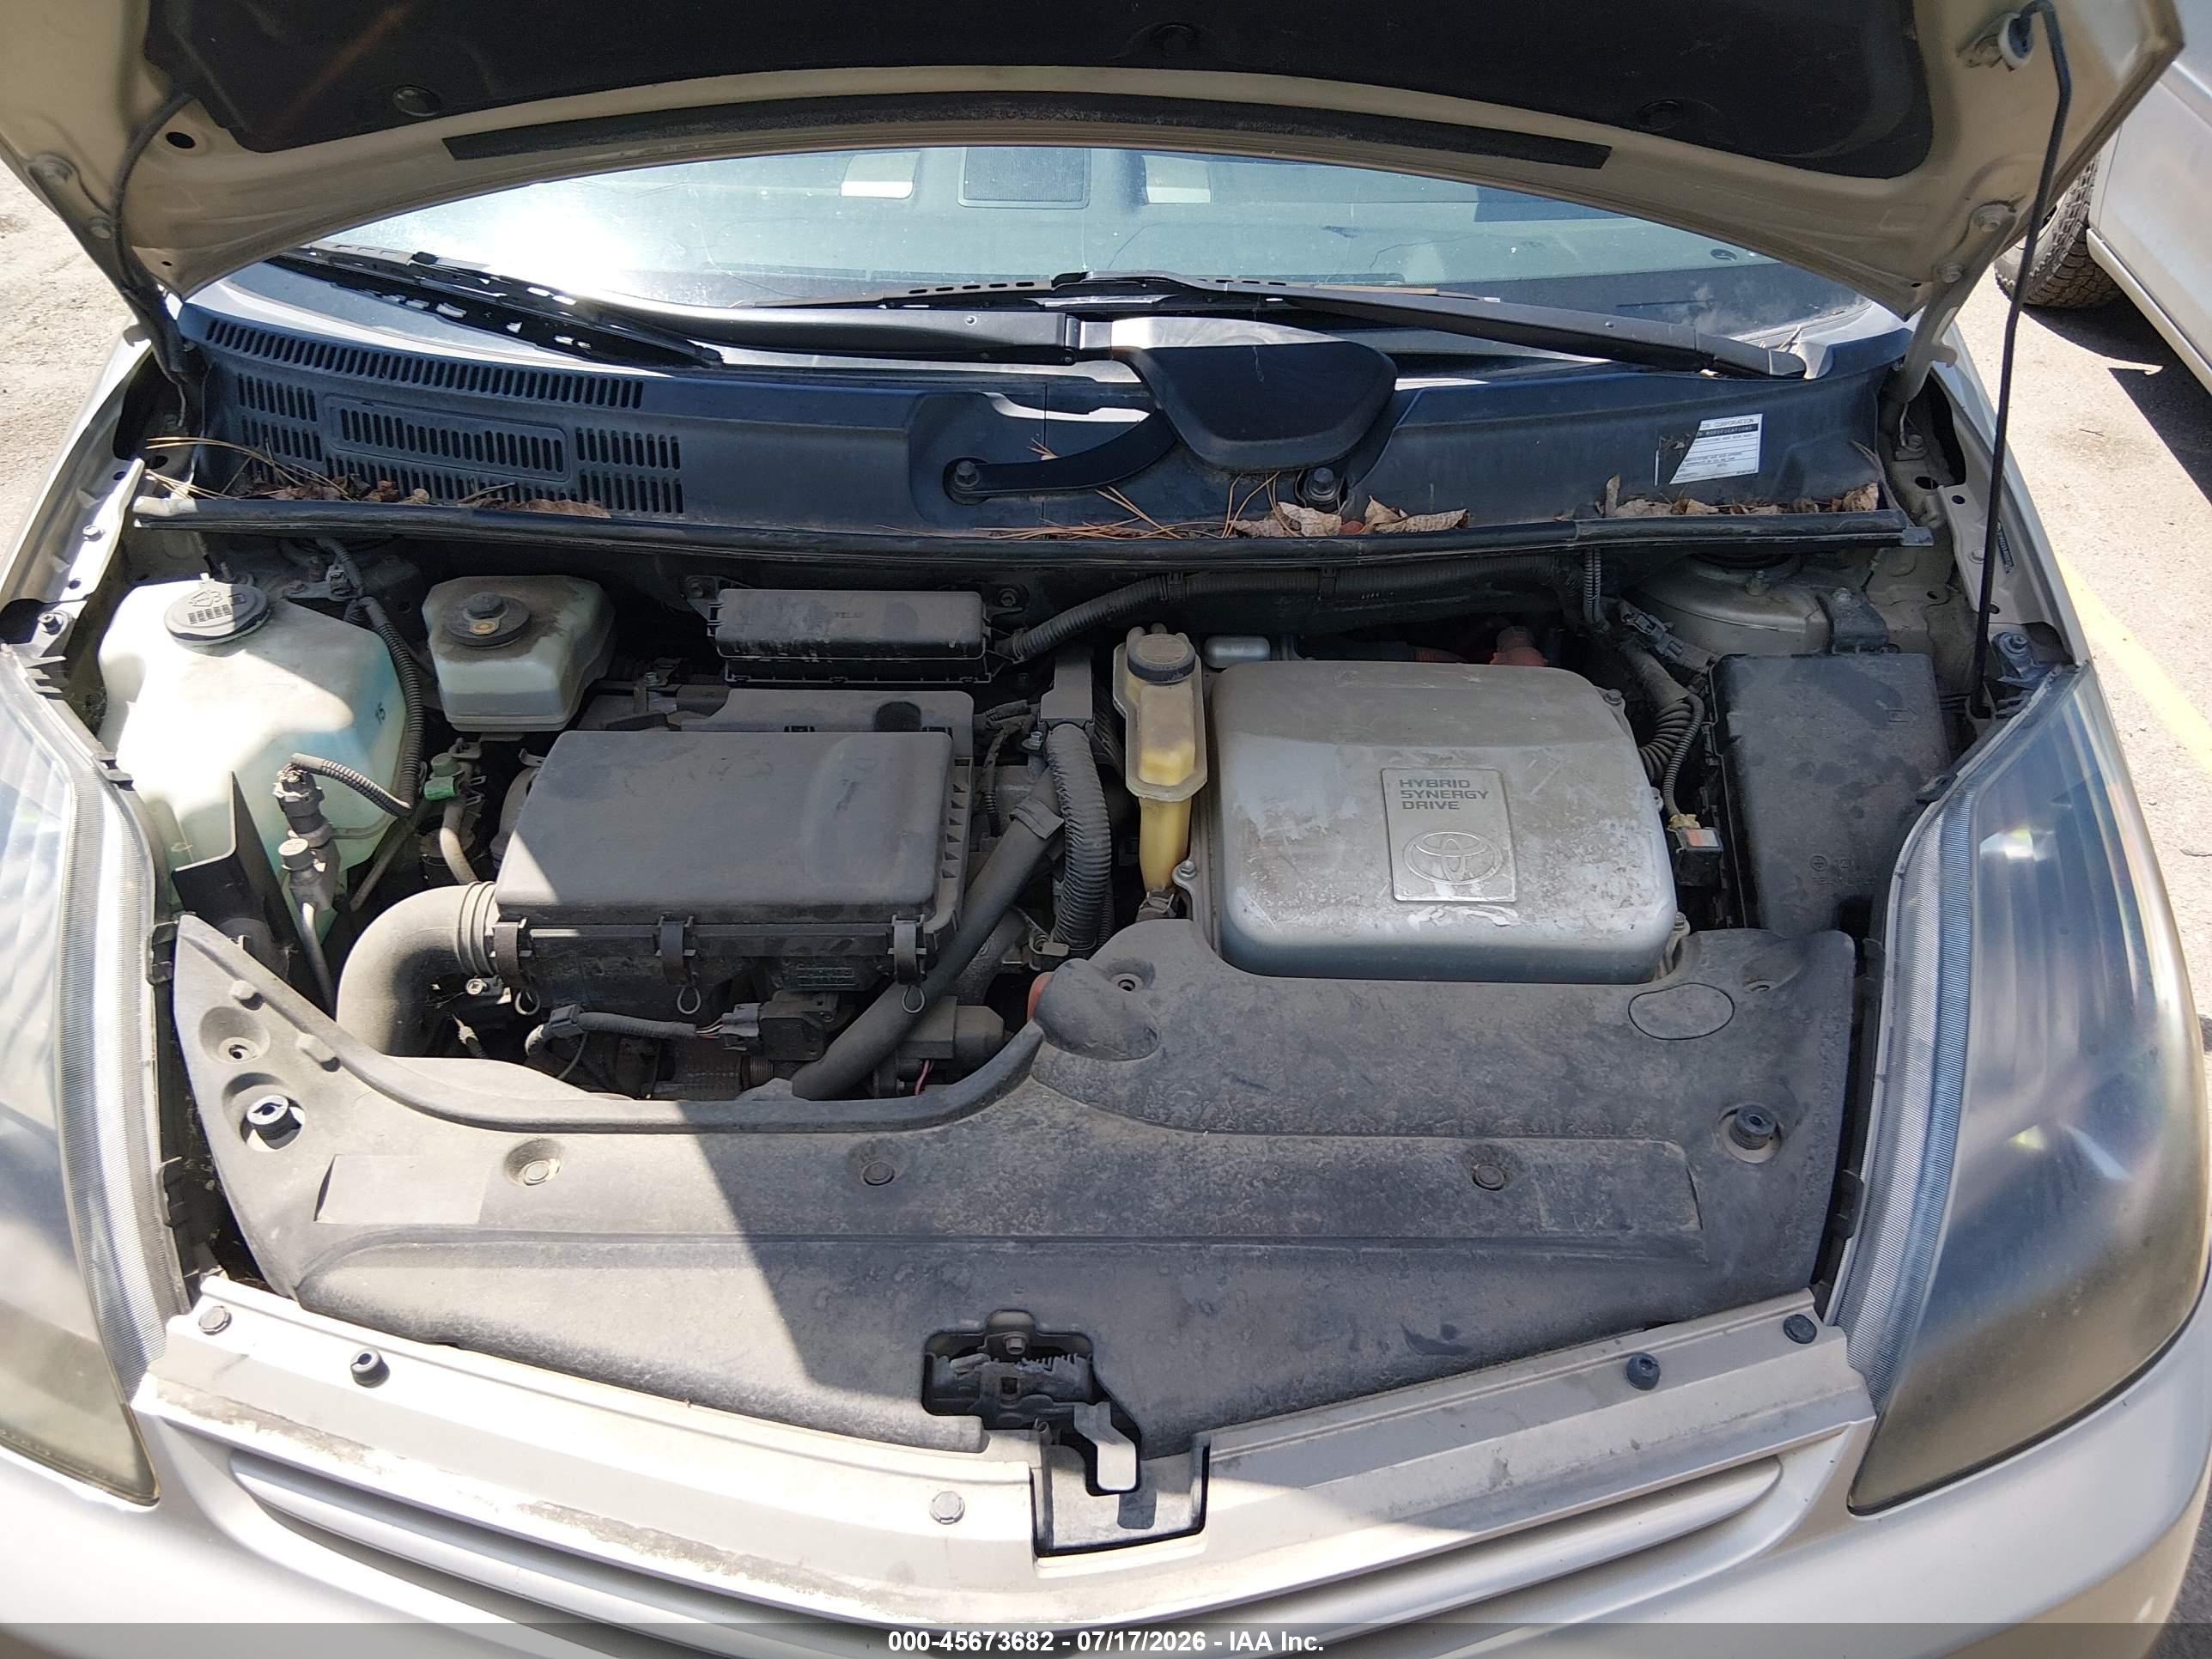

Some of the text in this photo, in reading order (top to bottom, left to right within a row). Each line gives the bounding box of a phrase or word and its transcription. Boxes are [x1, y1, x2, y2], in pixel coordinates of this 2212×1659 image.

[1399, 779, 1471, 788] HYBRID
[1401, 790, 1490, 799] SYNERGY
[1402, 800, 1460, 810] DRIVE
